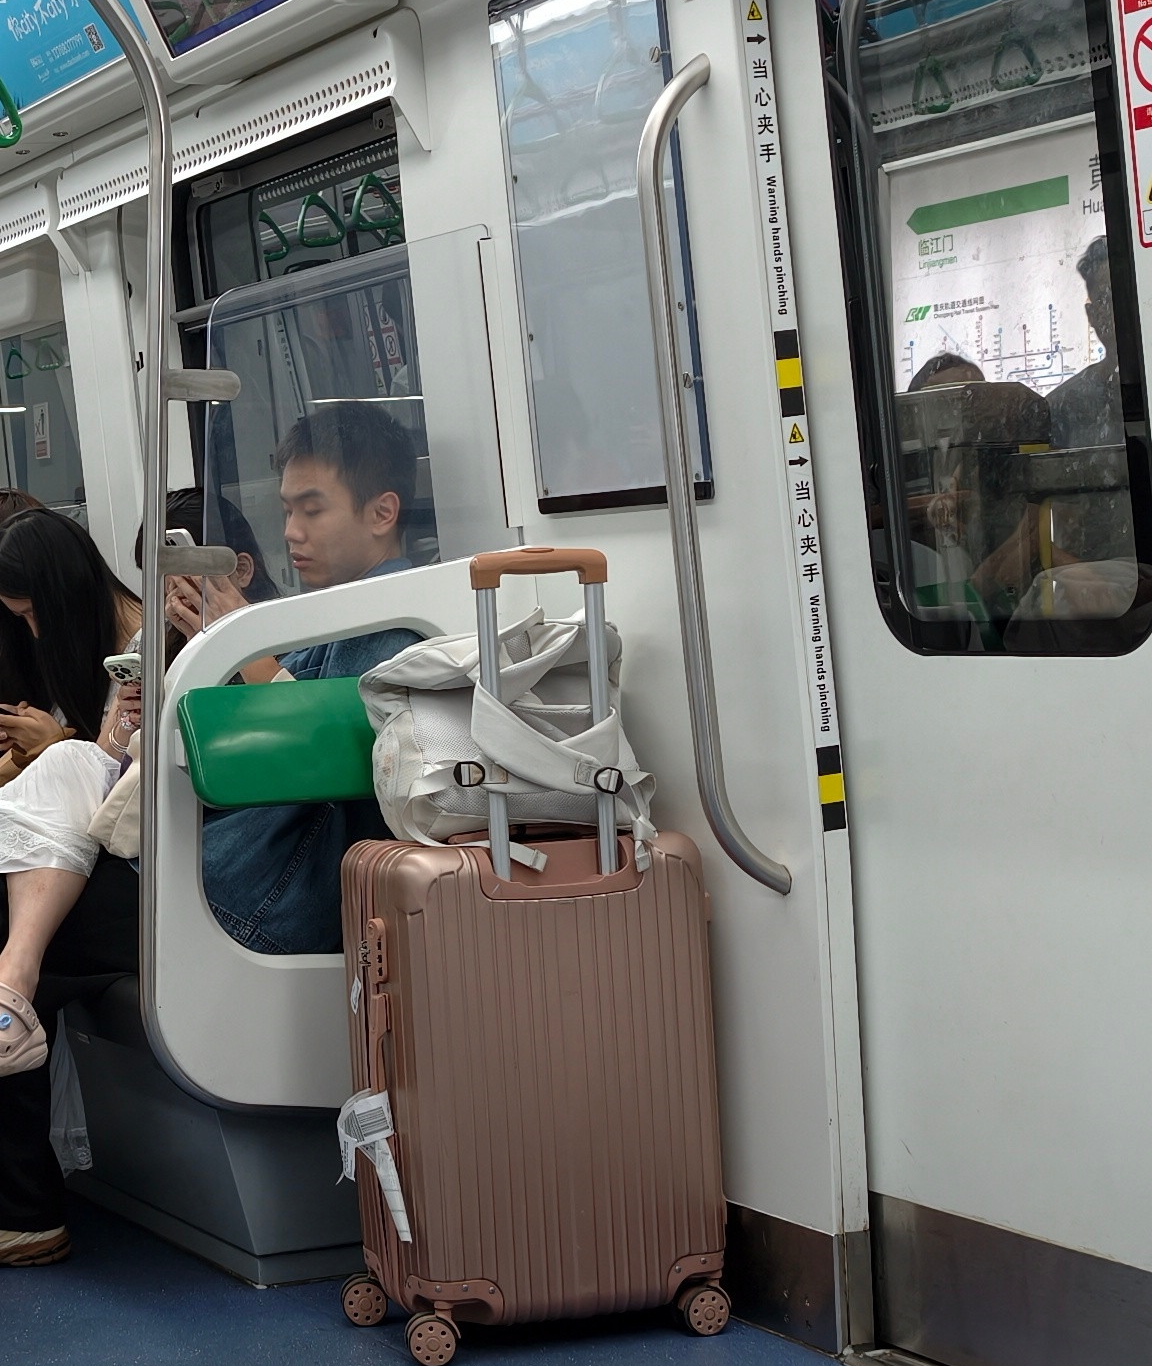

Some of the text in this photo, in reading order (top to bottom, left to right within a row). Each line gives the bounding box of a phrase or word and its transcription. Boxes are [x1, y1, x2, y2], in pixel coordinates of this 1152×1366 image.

[752, 58, 776, 163] 当心夹手
[766, 175, 787, 316] Warning hands pinching
[919, 234, 954, 256] 临江门
[795, 479, 820, 583] 当心夹手
[809, 594, 830, 733] Warning hands pinching
